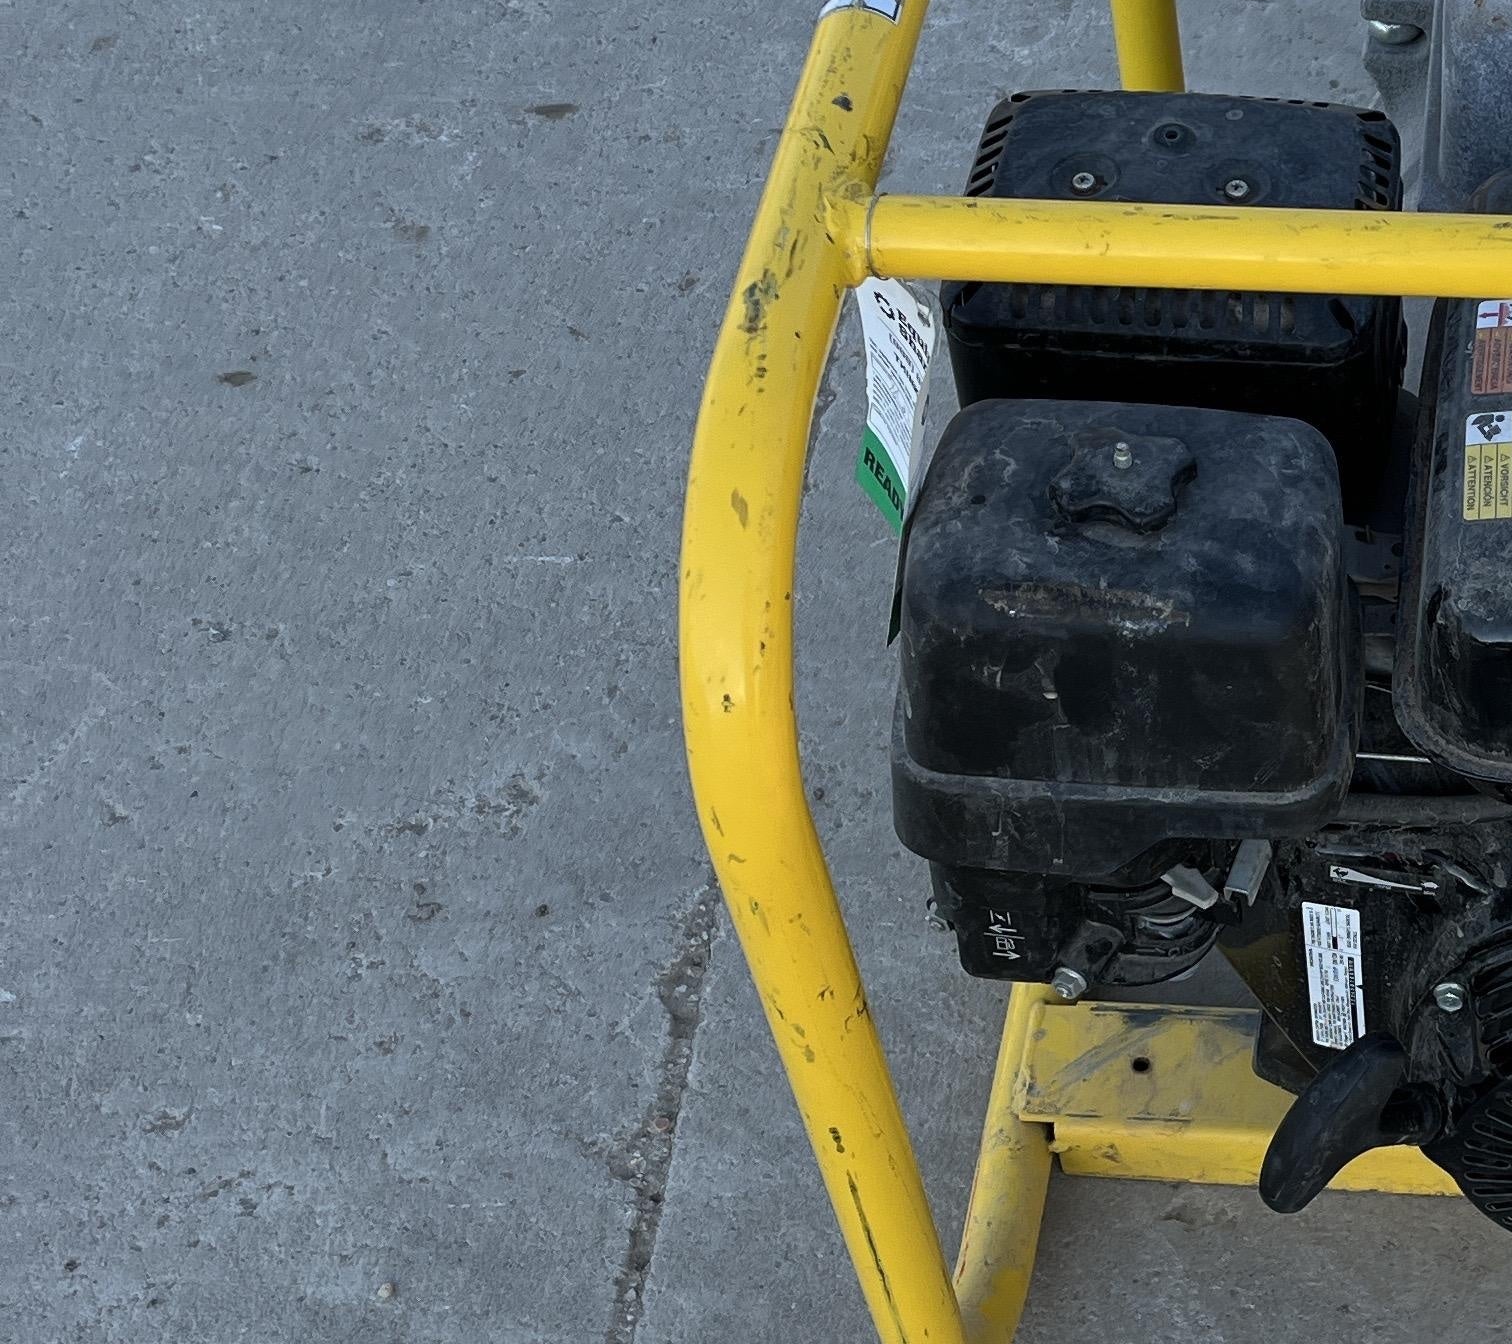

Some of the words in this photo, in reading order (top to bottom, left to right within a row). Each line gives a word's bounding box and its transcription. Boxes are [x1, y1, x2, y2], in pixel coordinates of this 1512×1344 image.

[1466, 464, 1478, 512] ATTENTION
[1482, 464, 1495, 508] ATENCIÓN
[1499, 463, 1510, 506] VORSICHT
